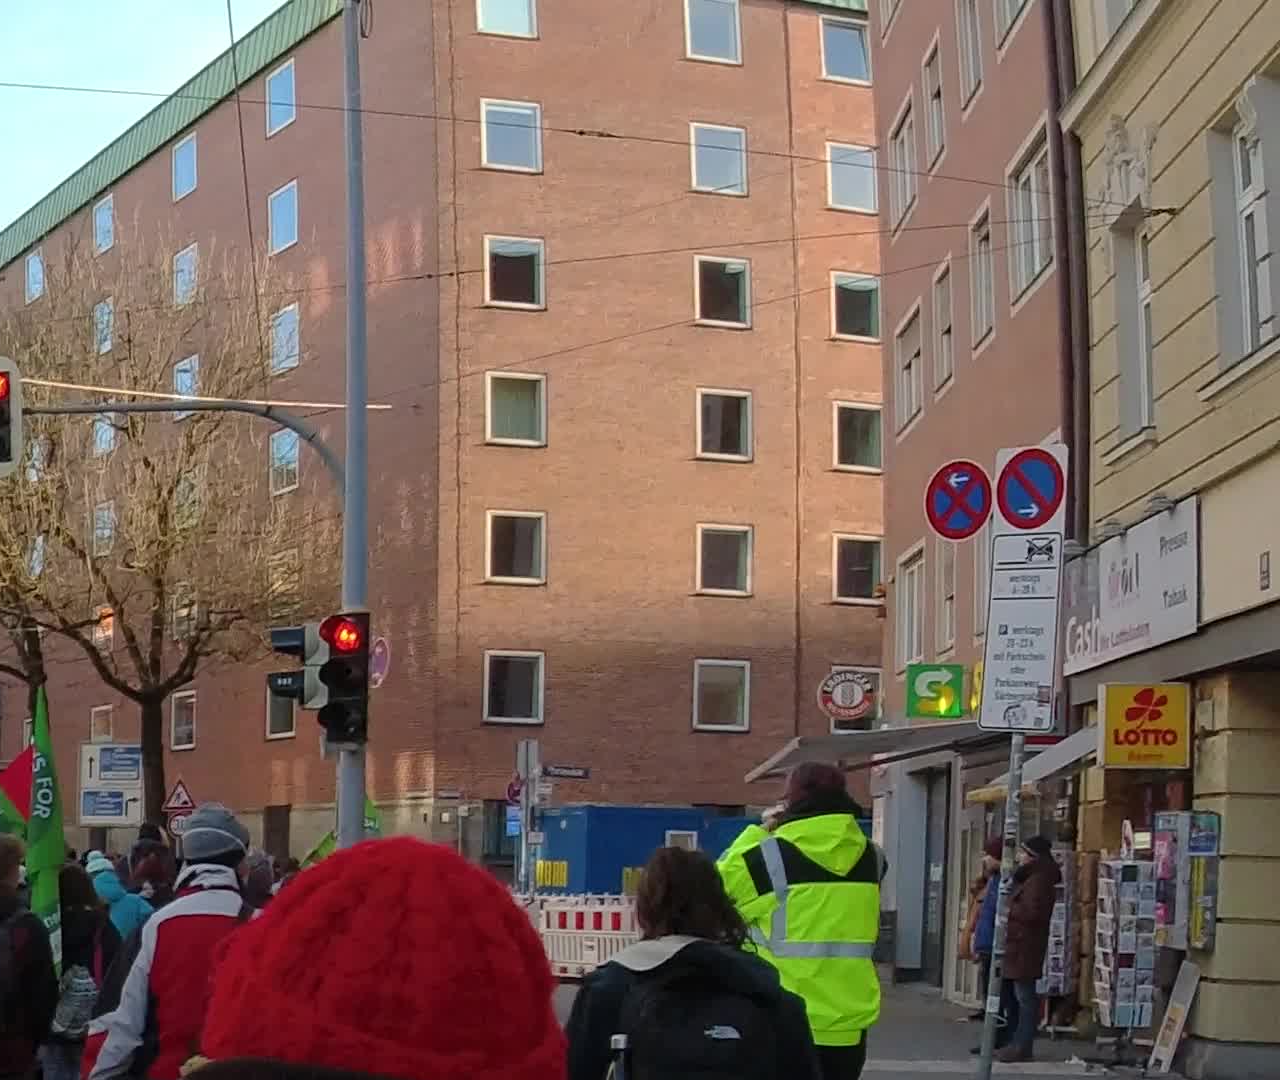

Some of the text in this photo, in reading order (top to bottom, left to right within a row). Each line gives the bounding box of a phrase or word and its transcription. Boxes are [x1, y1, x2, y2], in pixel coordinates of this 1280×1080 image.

[1066, 605, 1101, 657] Cash
[1113, 728, 1178, 746] LOTTO
[33, 777, 53, 819] FOR
